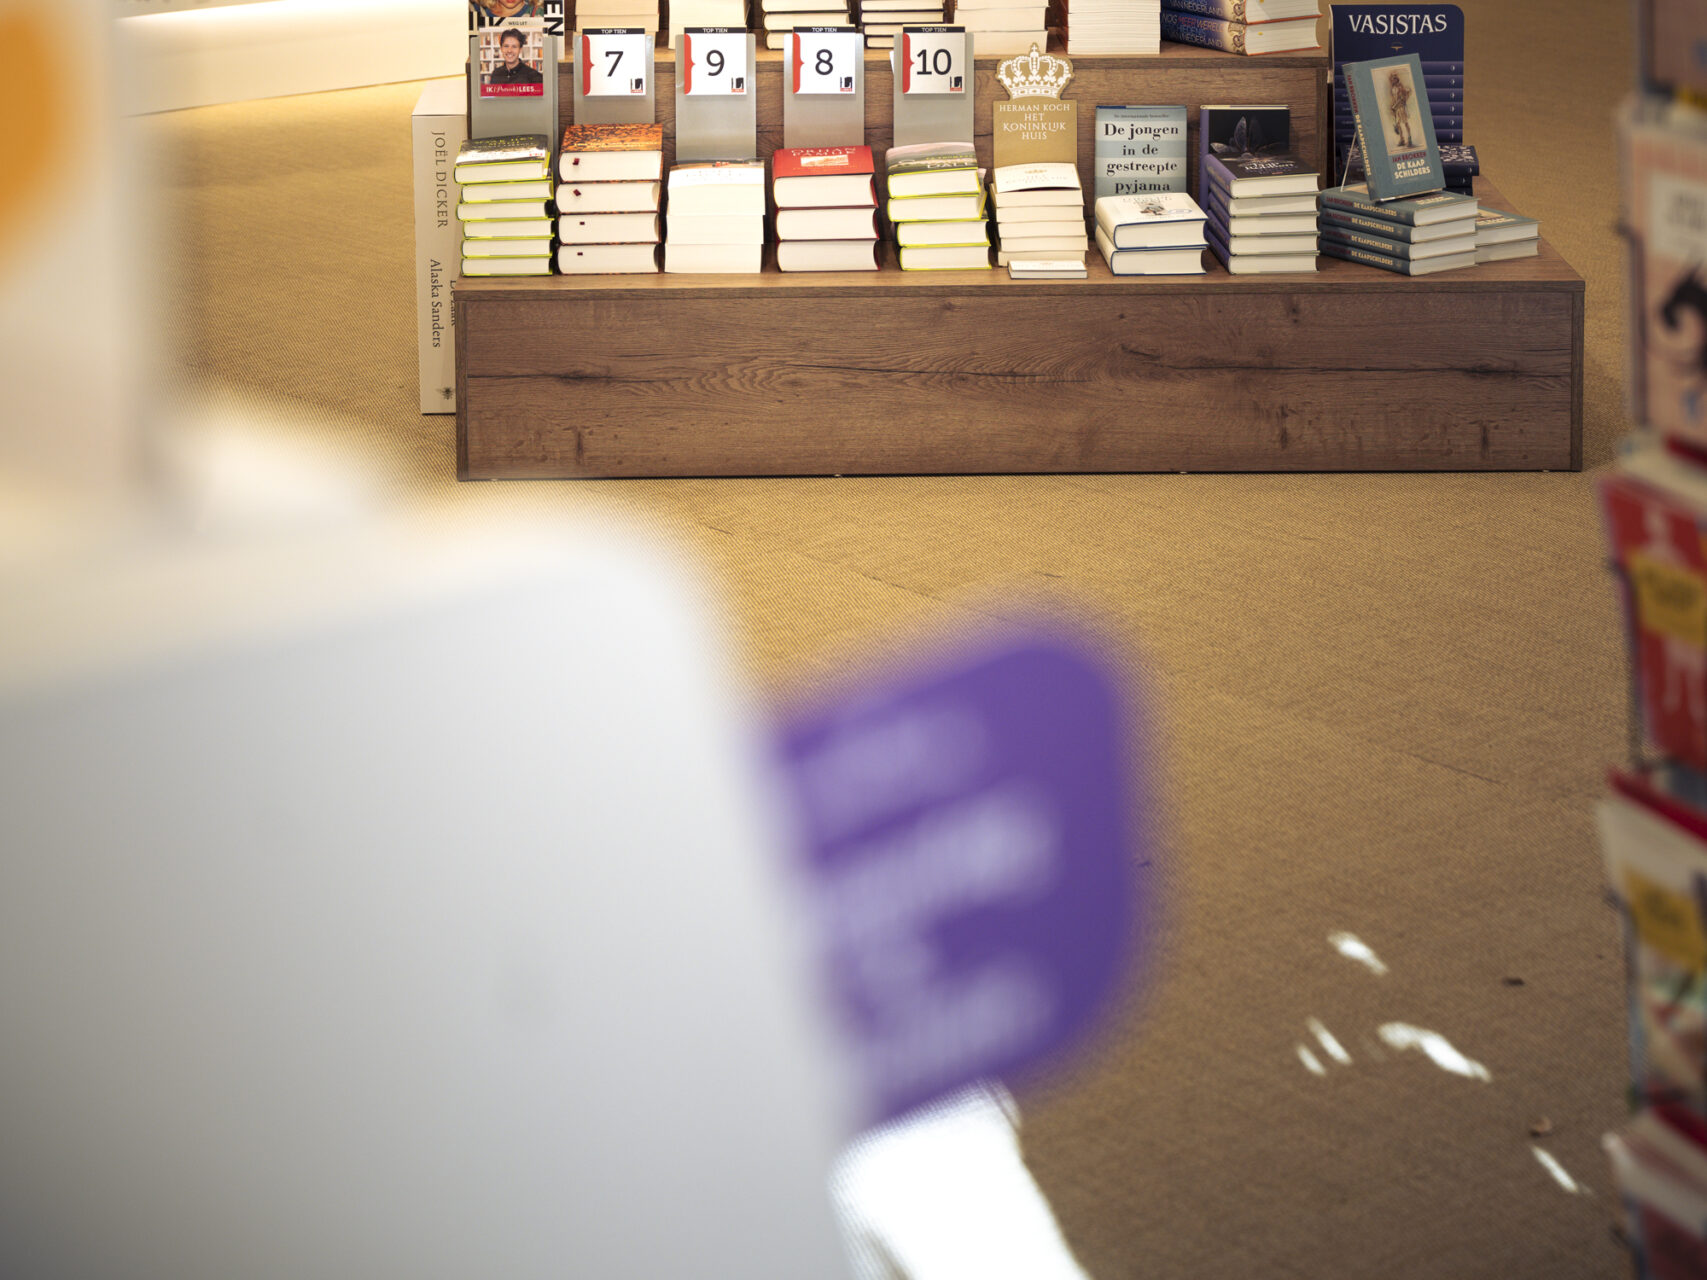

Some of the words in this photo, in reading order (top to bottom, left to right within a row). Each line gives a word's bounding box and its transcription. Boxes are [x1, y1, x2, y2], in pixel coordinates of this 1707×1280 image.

[1348, 13, 1448, 35] VASISTAS
[605, 50, 624, 77] 7
[706, 49, 725, 77] 9
[814, 48, 834, 76] 8
[916, 48, 952, 76] 10
[999, 104, 1042, 112] HERMAN
[1043, 103, 1070, 112] KOCH
[1024, 113, 1045, 121] HET
[1003, 122, 1067, 132] KONINKLIJK
[1104, 123, 1125, 136] De
[1127, 123, 1179, 141] jongen
[1022, 131, 1048, 140] HUIS
[431, 131, 446, 167] JOËL
[1122, 144, 1136, 156] in
[1142, 144, 1159, 155] de
[1106, 161, 1178, 176] gestreepte
[1396, 162, 1406, 170] DE
[1407, 159, 1425, 170] KAAP
[1394, 167, 1431, 180] SCHILDERS
[1115, 179, 1171, 195] pyjama
[435, 171, 449, 229] DICKER
[1360, 203, 1397, 217] KAAPSCHILDERS
[1358, 218, 1394, 233] KAAPSCHILDERS
[1358, 236, 1393, 251] KAAPSCHILDERS
[1358, 251, 1393, 266] KAAPSCHILDERS
[430, 259, 441, 299] Alaska
[432, 300, 443, 349] Sanders
